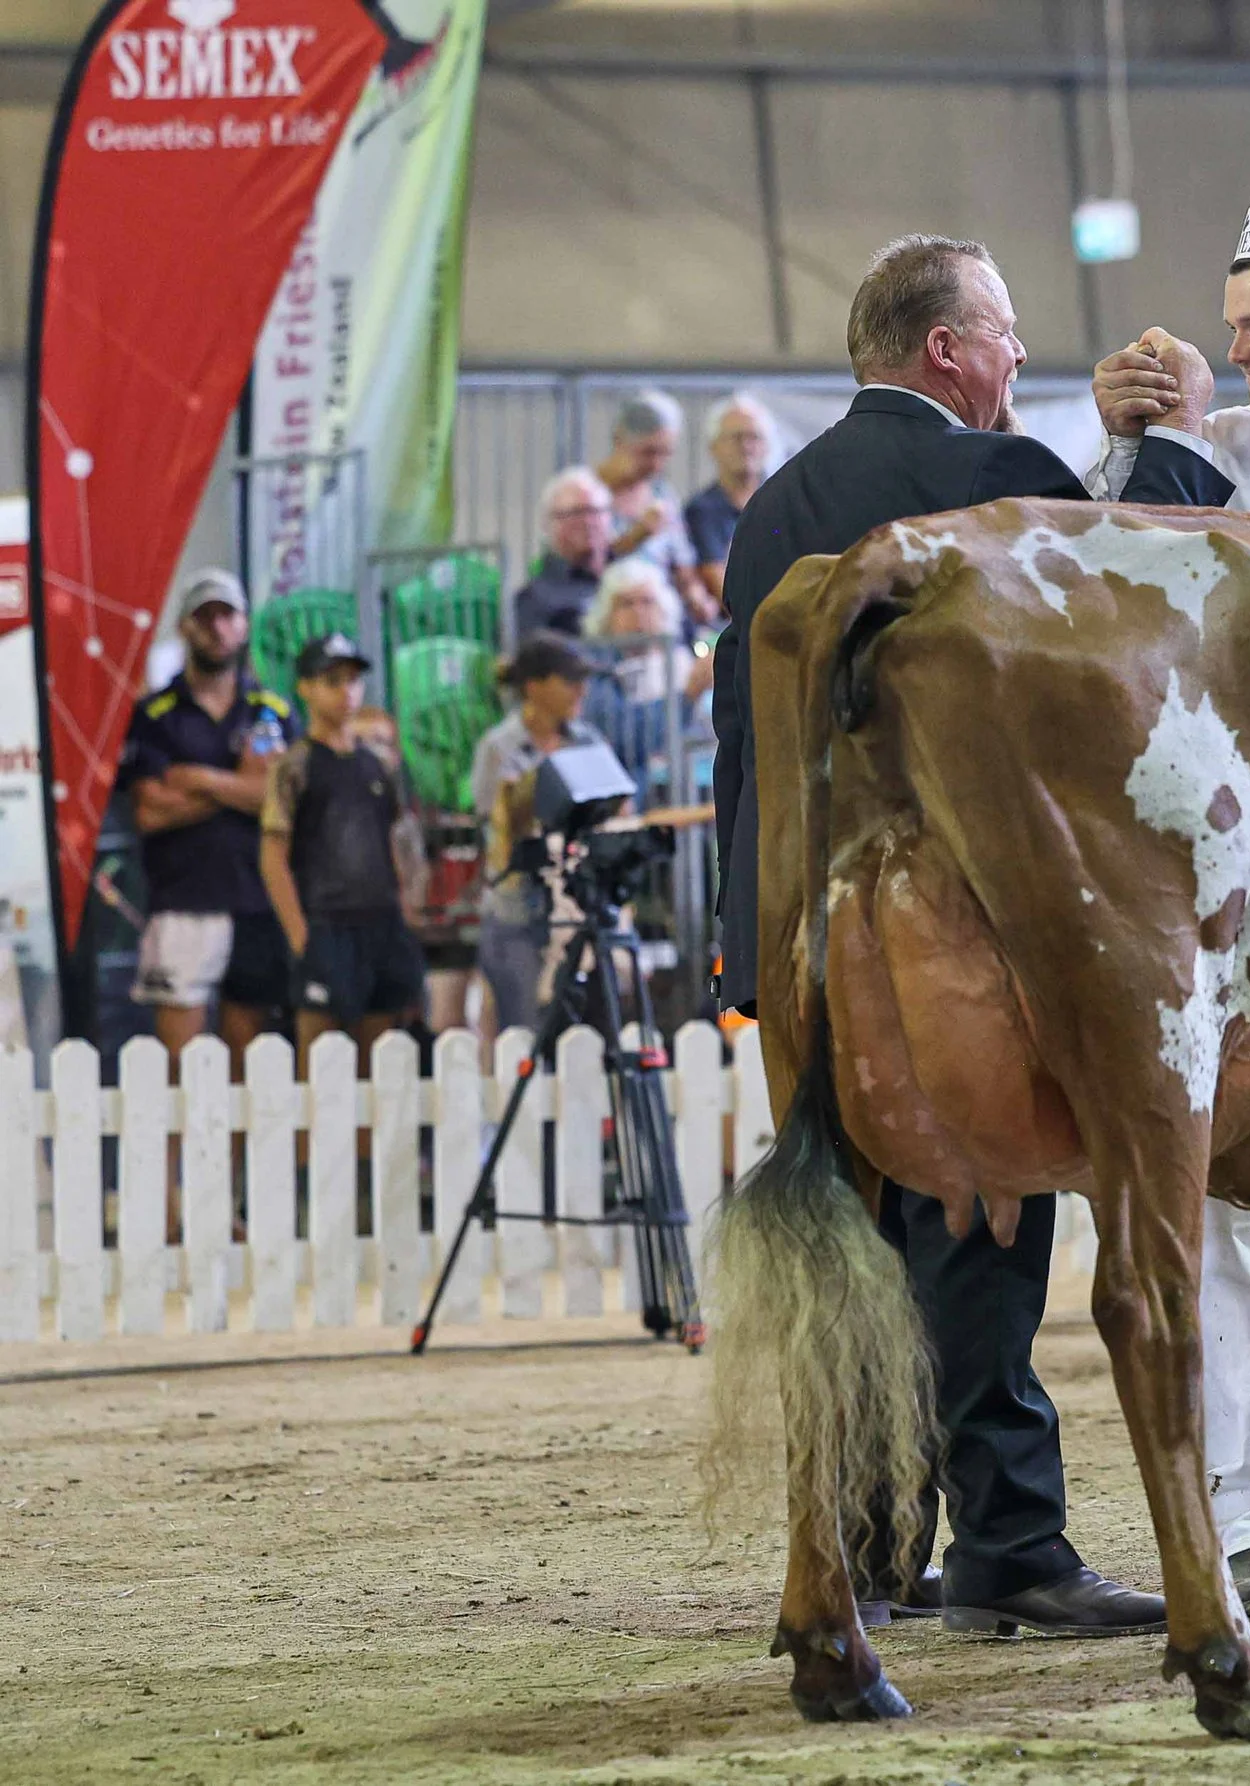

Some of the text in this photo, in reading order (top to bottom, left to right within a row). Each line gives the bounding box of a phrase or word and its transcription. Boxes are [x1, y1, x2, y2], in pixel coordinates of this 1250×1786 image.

[109, 27, 302, 99] SEMEX
[87, 117, 216, 152] Genetics
[219, 113, 264, 148] for
